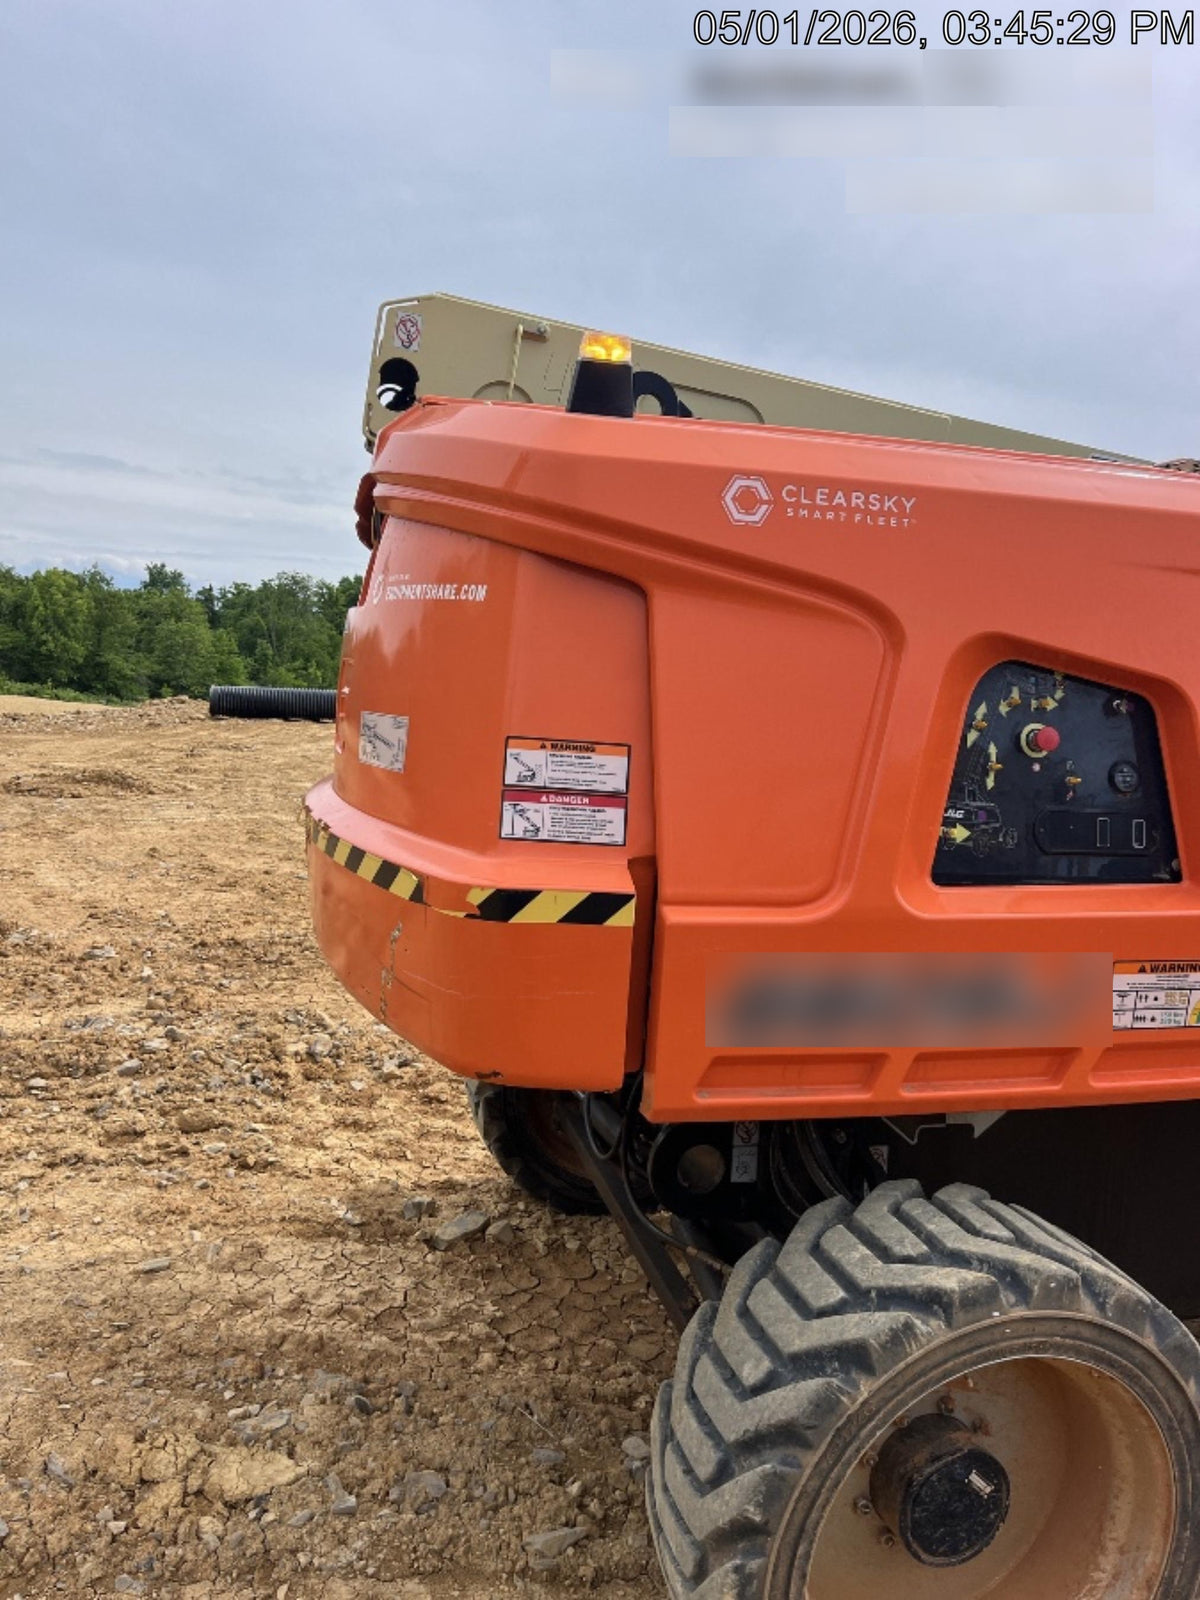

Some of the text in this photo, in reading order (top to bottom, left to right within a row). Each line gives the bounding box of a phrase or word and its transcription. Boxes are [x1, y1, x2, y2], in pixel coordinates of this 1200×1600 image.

[781, 484, 917, 514] CLEARSKY
[786, 508, 910, 527] SMART FLEET
[550, 742, 596, 752] WARNING
[549, 794, 590, 805] DANGER
[1150, 962, 1200, 973] WARNIN
